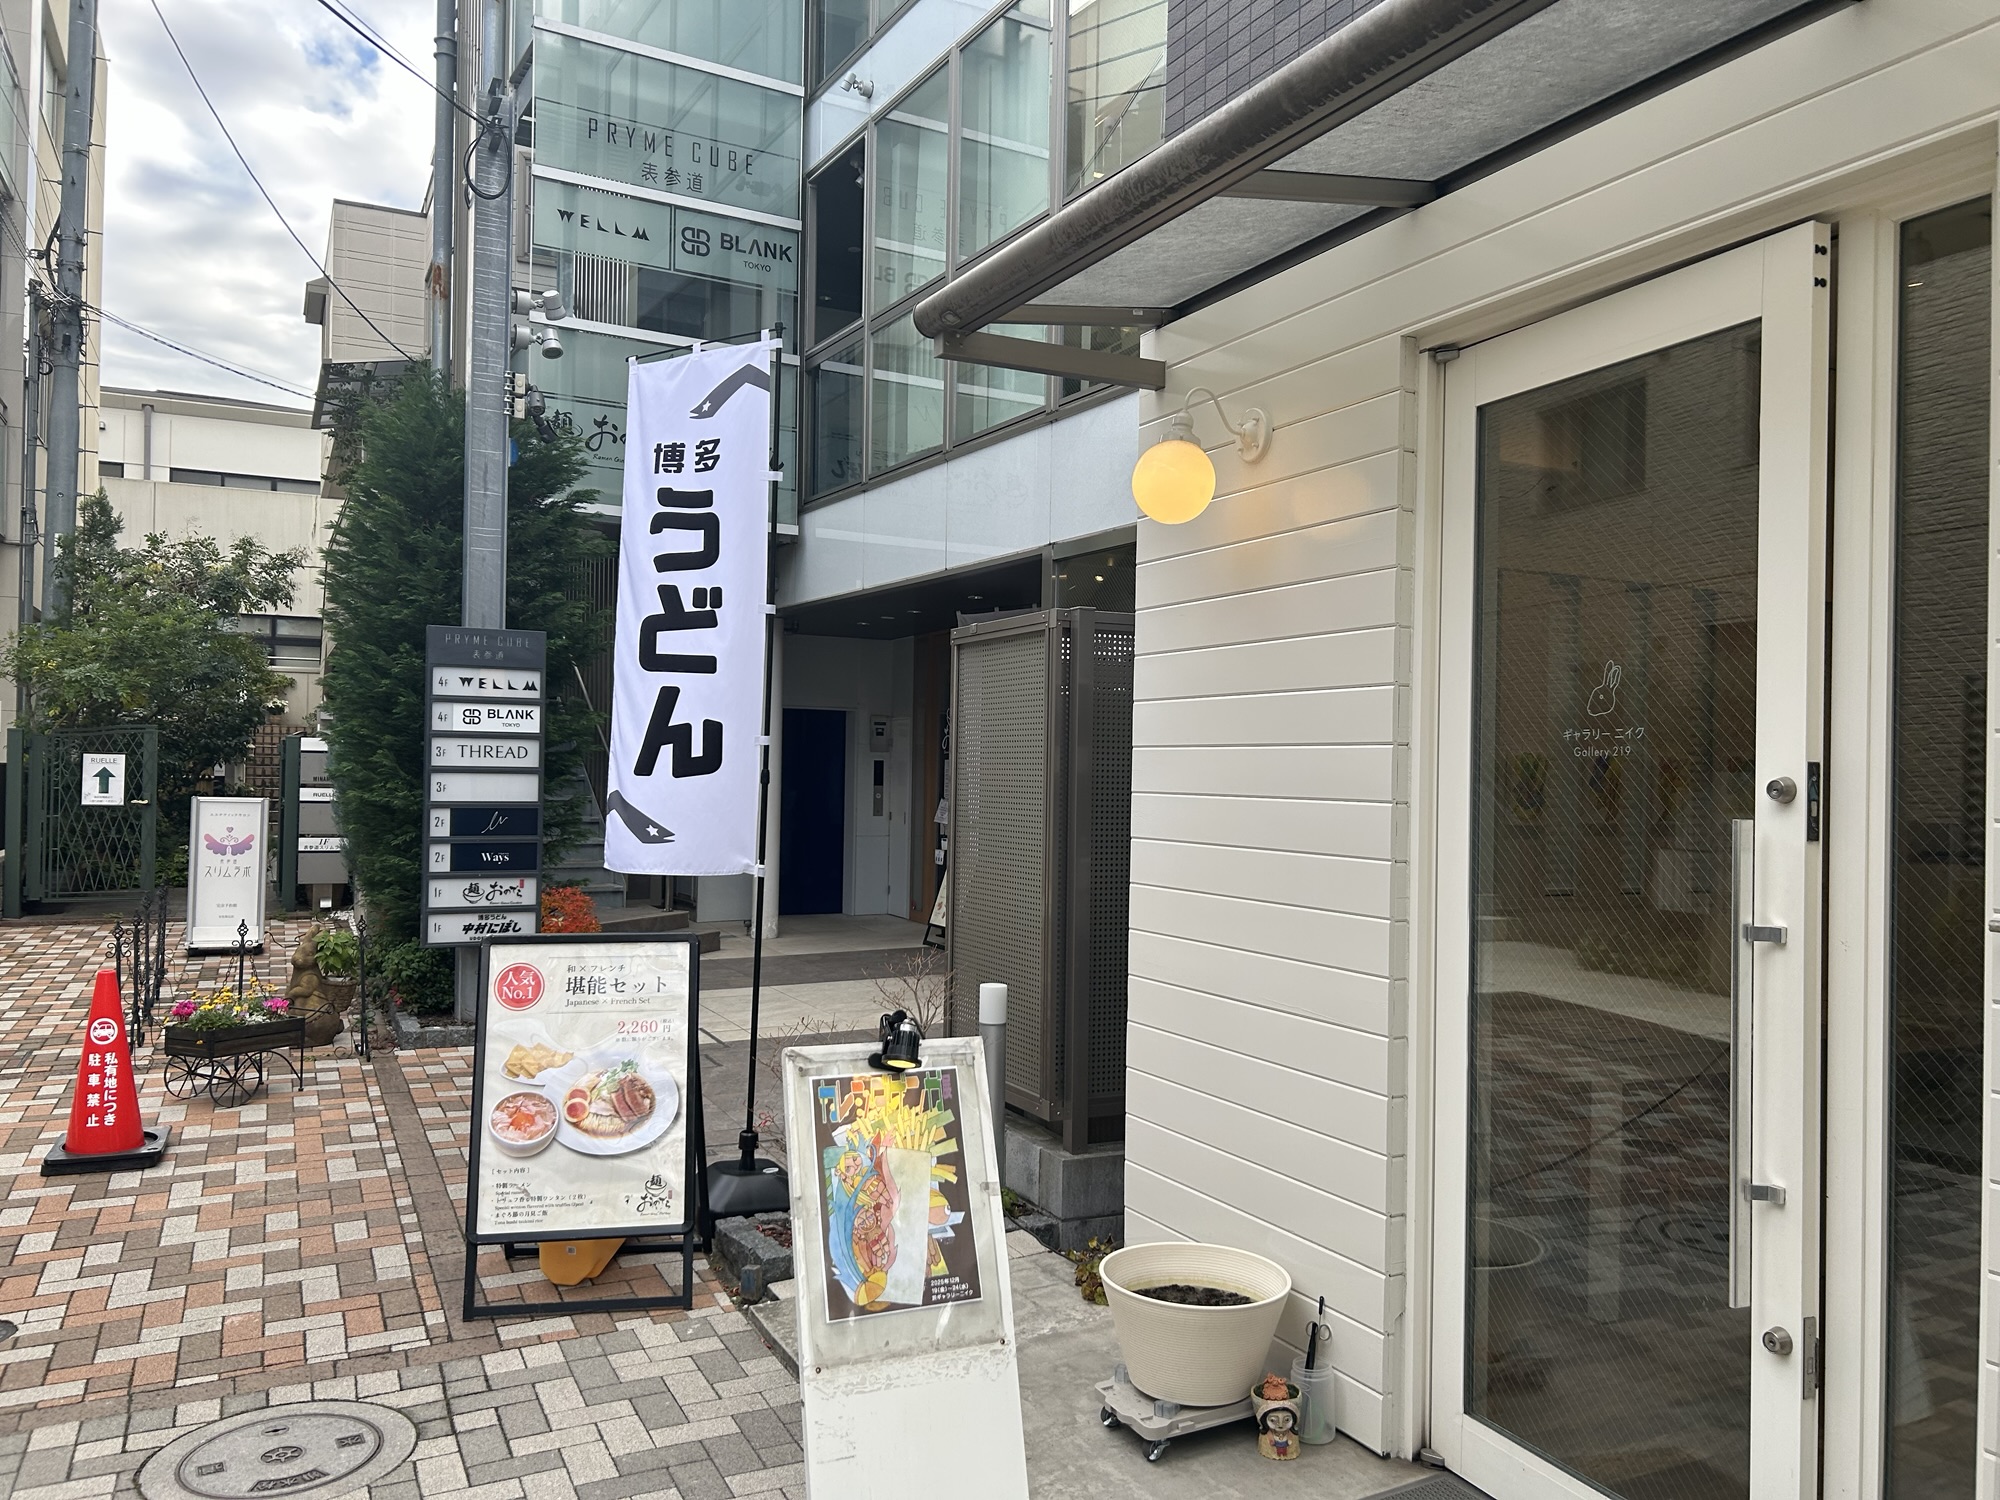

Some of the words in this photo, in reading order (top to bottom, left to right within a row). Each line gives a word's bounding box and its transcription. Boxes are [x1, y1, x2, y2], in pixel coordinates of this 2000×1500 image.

[588, 117, 673, 157] PRYME
[692, 142, 753, 175] CUBE
[641, 162, 703, 193] 表参道
[720, 232, 793, 263] BLANK
[743, 260, 771, 273] TOKYO
[653, 438, 721, 474] 博多
[633, 486, 723, 779] うどん
[445, 633, 488, 646] PRYME
[497, 636, 529, 648] CUBE
[473, 649, 504, 660] 表参道
[438, 676, 448, 687] 4F
[438, 712, 448, 722] 4F
[487, 709, 534, 720] BLANK
[1562, 728, 1611, 740] ギャラリー
[1614, 727, 1644, 739] ニイク
[436, 746, 446, 757] 3F
[457, 745, 528, 758] THREAD
[1573, 746, 1610, 759] Gallery
[1612, 745, 1631, 757] 219
[436, 781, 447, 792] 3F
[434, 816, 445, 828] 2F
[434, 852, 445, 863] 2F
[481, 852, 510, 865] Ways
[204, 866, 251, 878] スリムラボ
[434, 887, 442, 898] 1F
[434, 923, 442, 933] 1F
[462, 919, 522, 934] 中村にぼし
[502, 970, 536, 987] 人気
[565, 975, 668, 996] 堪能セット
[501, 987, 534, 1001] No.1
[565, 998, 599, 1008] Japanese
[610, 997, 637, 1006] French
[638, 997, 651, 1005] Set
[617, 1020, 658, 1035] 2,260
[86, 1053, 101, 1127] 駐車禁止
[103, 1052, 118, 1126] 私有地につき
